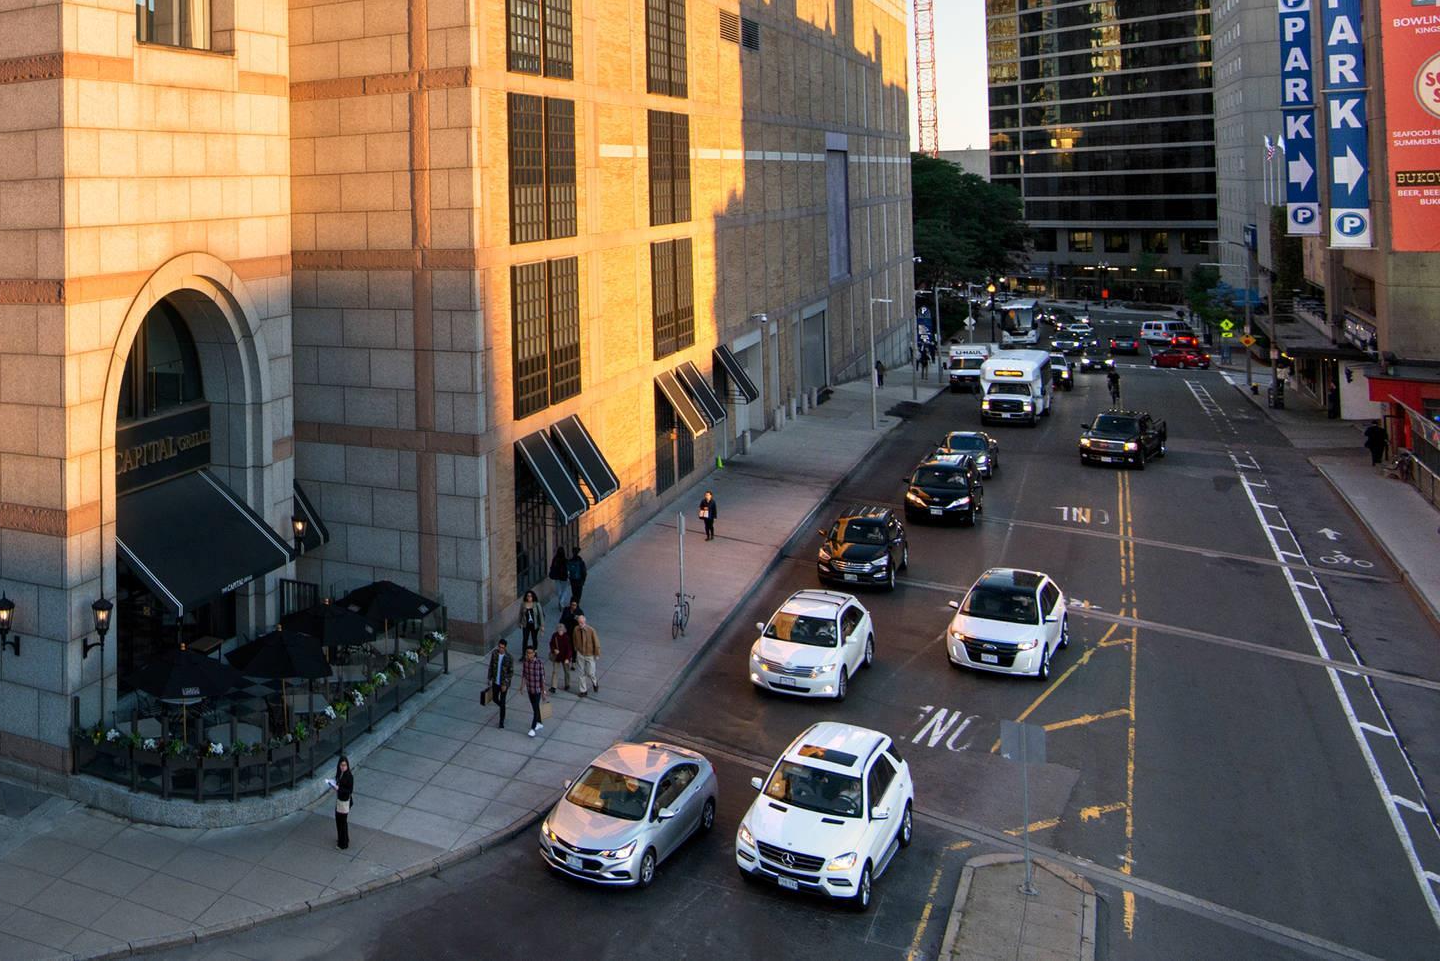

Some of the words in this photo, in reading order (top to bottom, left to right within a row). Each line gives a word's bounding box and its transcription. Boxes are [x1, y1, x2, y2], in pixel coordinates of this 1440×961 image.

[1283, 17, 1313, 140] PARK
[1392, 130, 1431, 138] SEAFOOD
[1297, 209, 1311, 223] P
[1343, 216, 1361, 233] P
[116, 436, 178, 476] CAPITAL
